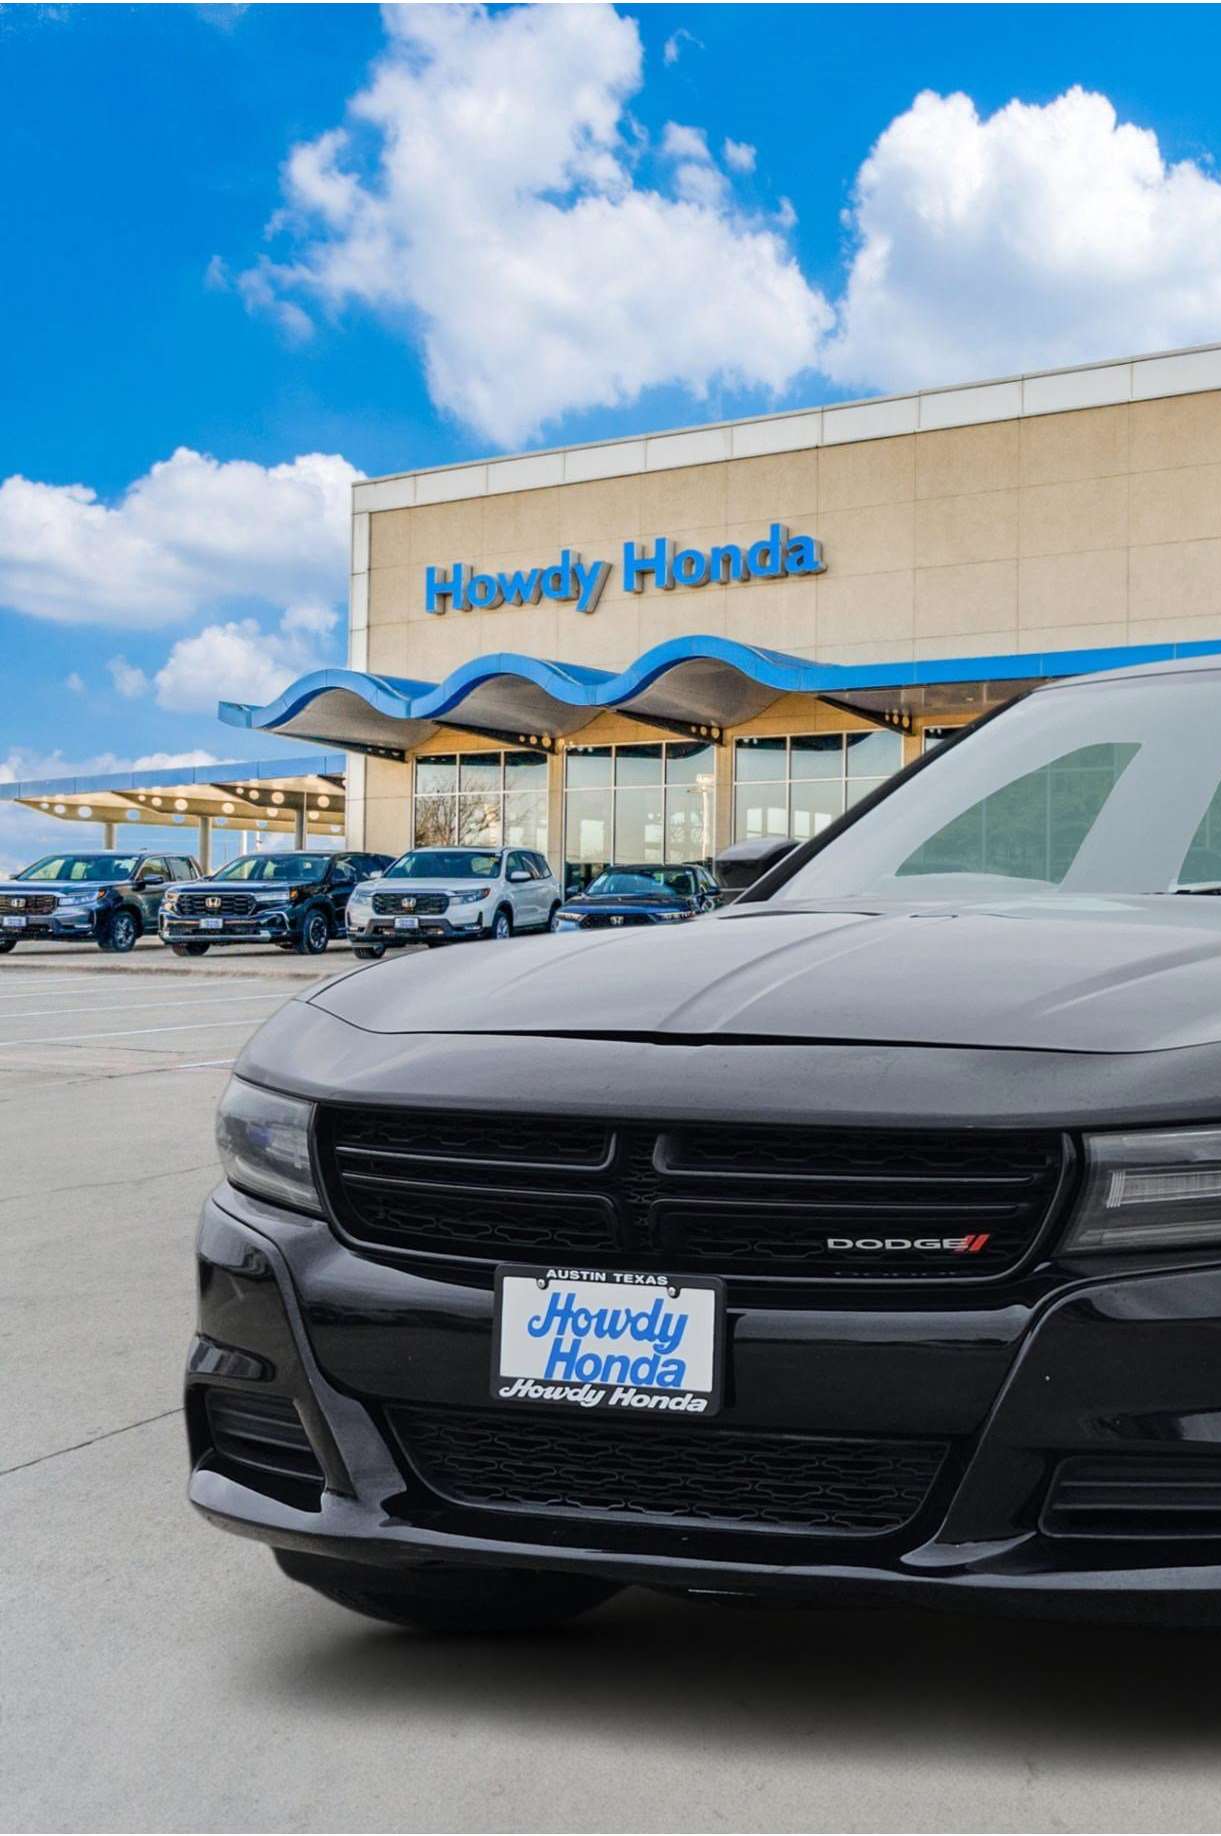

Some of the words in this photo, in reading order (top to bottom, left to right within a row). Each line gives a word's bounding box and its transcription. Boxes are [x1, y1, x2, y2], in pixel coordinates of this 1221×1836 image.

[425, 549, 610, 614] Howdy
[623, 523, 824, 594] Honda
[827, 1238, 968, 1250] DODGE
[547, 1269, 606, 1282] AUSTIN
[613, 1273, 669, 1286] TEXAS
[527, 1292, 689, 1355] Howdy
[543, 1337, 687, 1388] Honda
[499, 1378, 605, 1408] Howdy
[609, 1387, 708, 1413] Honda
